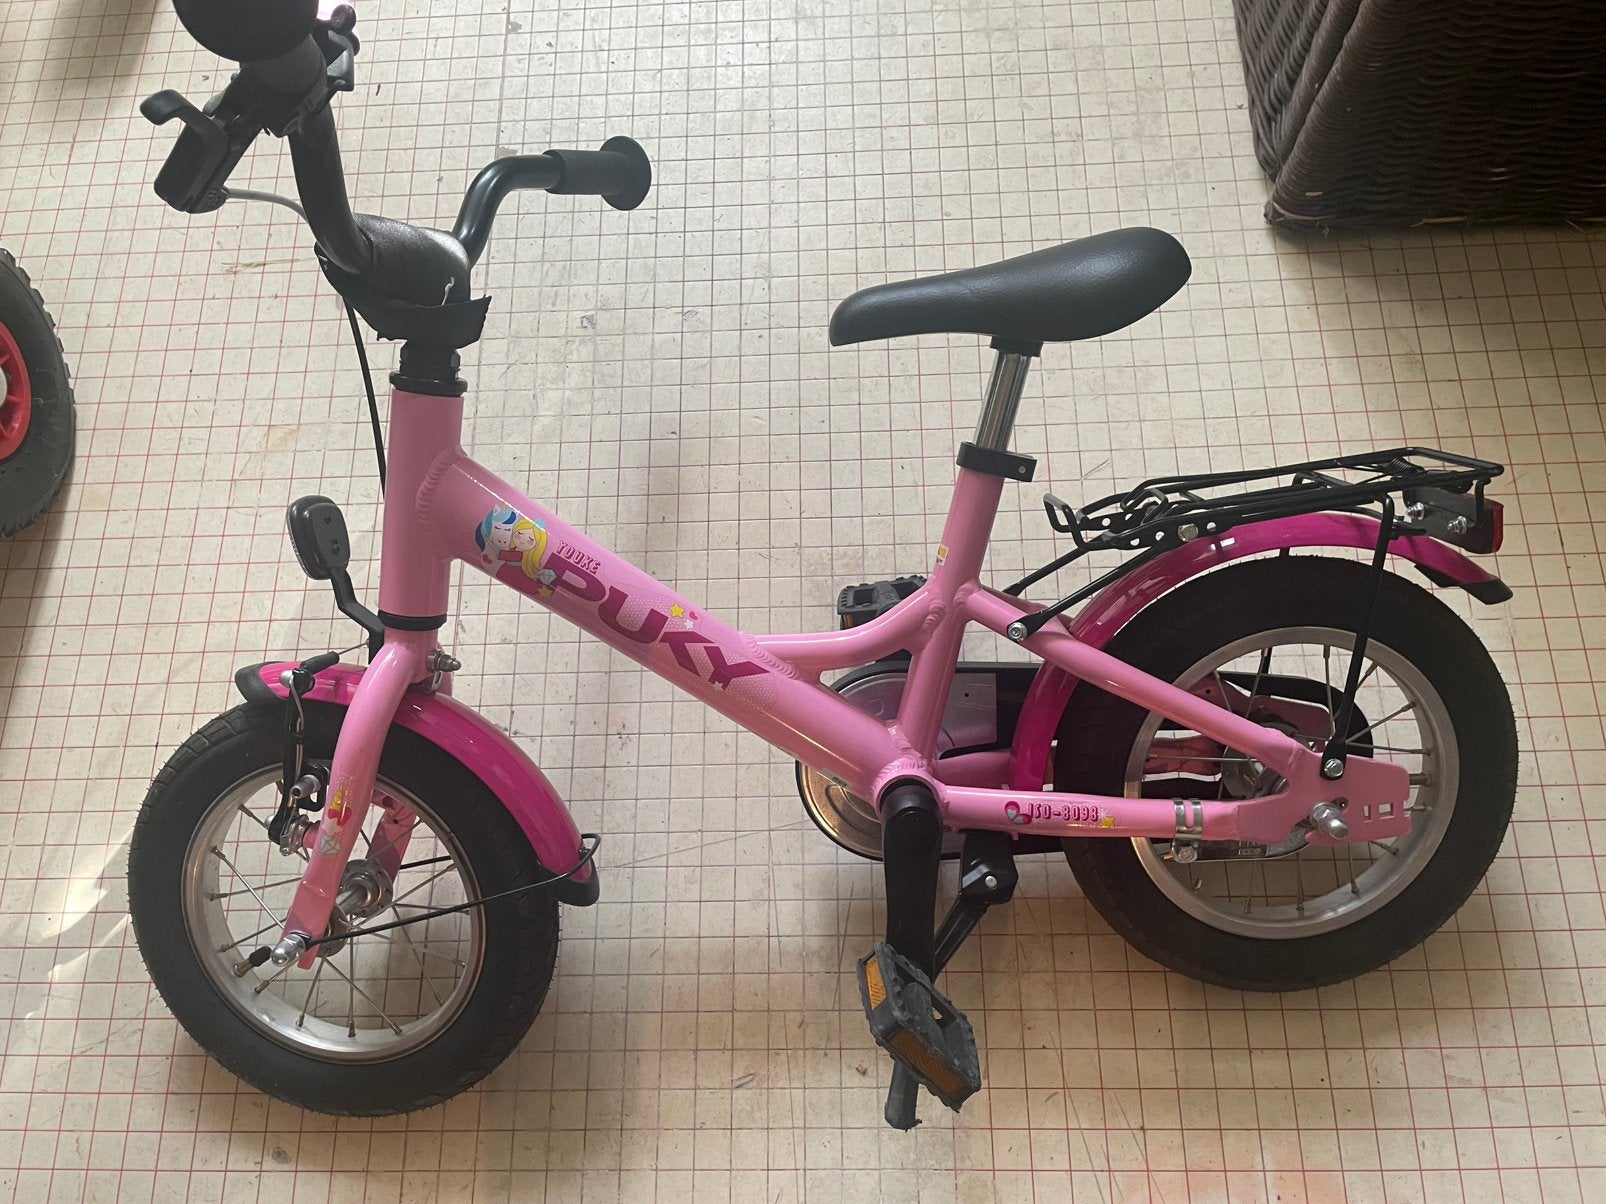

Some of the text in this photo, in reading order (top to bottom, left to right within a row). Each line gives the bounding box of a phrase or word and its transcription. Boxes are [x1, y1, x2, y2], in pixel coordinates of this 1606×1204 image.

[556, 539, 601, 575] YOUKE
[540, 552, 770, 690] PUKY
[1028, 803, 1099, 822] ISO-8098
